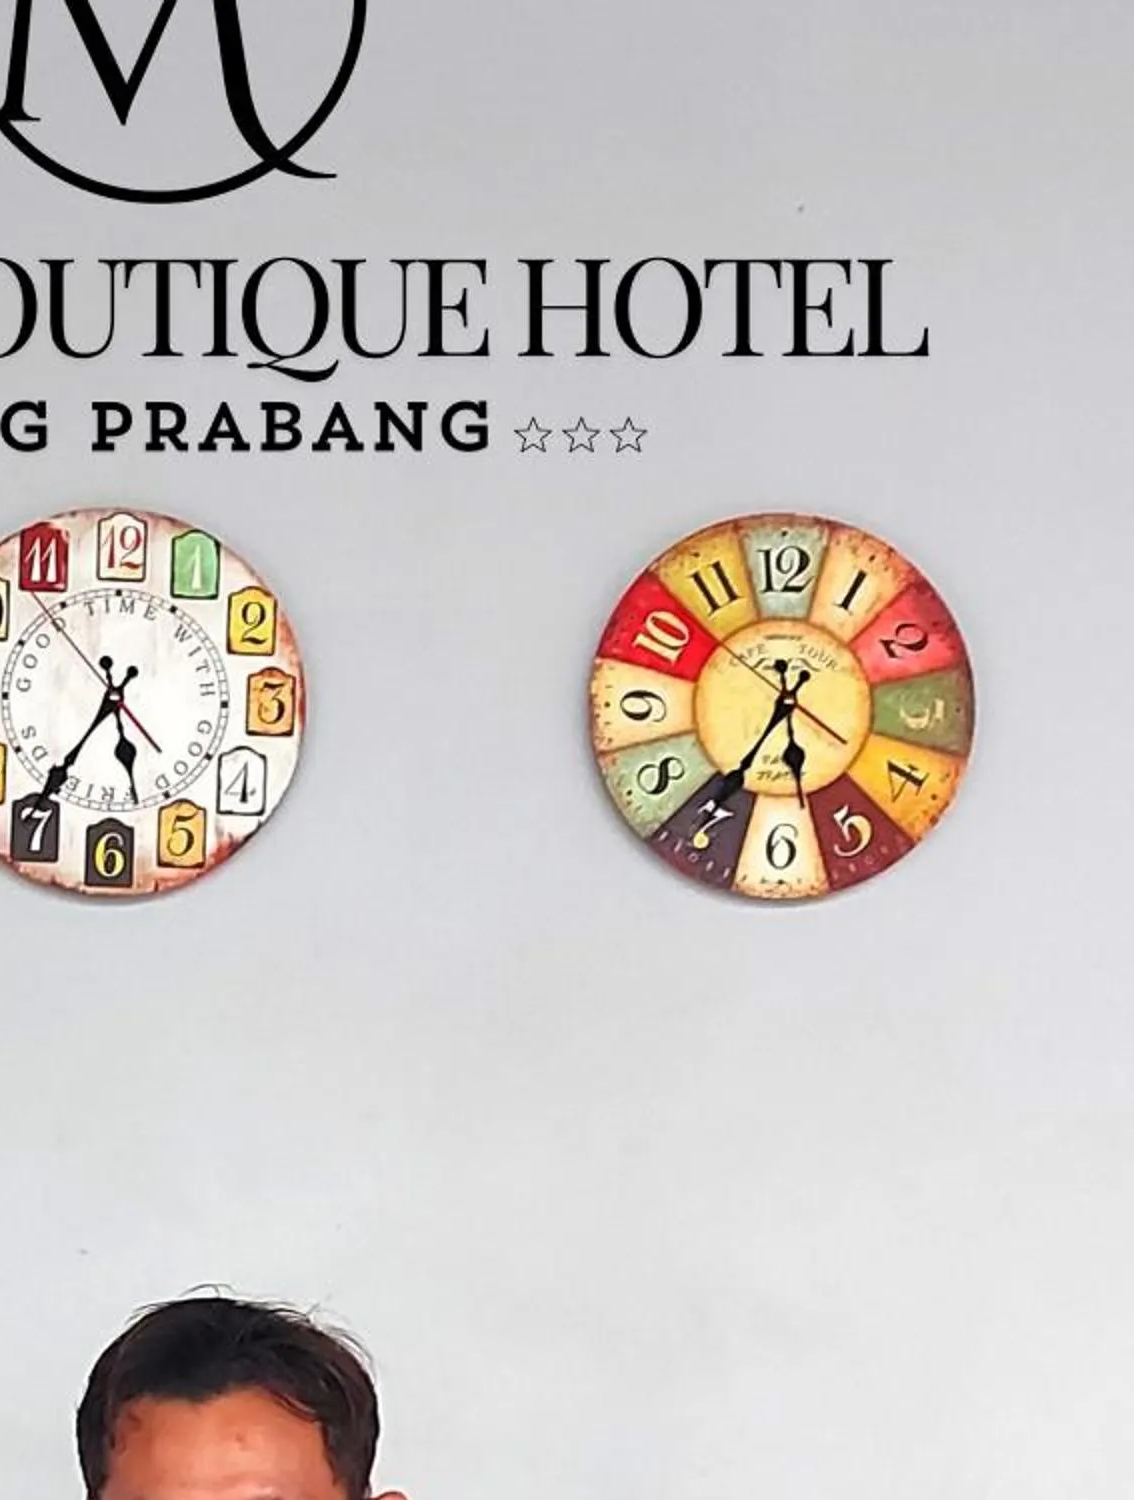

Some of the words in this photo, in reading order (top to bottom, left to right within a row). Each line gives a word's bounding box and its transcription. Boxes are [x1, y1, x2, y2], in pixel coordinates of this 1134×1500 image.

[517, 256, 930, 359] HOTEL
[91, 400, 490, 452] PRABANG
[24, 536, 58, 584] 11
[101, 524, 144, 571] 12
[186, 545, 204, 591] 1
[757, 546, 815, 594] 12
[83, 598, 158, 622] TIME
[689, 560, 744, 617] 11
[835, 568, 869, 616] 1
[241, 601, 269, 646] 2
[632, 610, 691, 663] 10
[879, 622, 929, 660] 2
[16, 616, 67, 693] GOOD
[172, 623, 217, 698] WITH
[256, 681, 286, 726] 3
[619, 689, 667, 723] 9
[21, 724, 137, 801] FRIEDS
[154, 719, 214, 791] GOOD
[636, 755, 686, 795] 8
[224, 760, 257, 804] 4
[887, 759, 930, 804] 4
[20, 805, 54, 854] 7
[165, 811, 196, 858] 5
[692, 799, 735, 850] 7
[765, 822, 799, 871] 6
[832, 804, 873, 858] 5
[94, 832, 126, 878] 6
